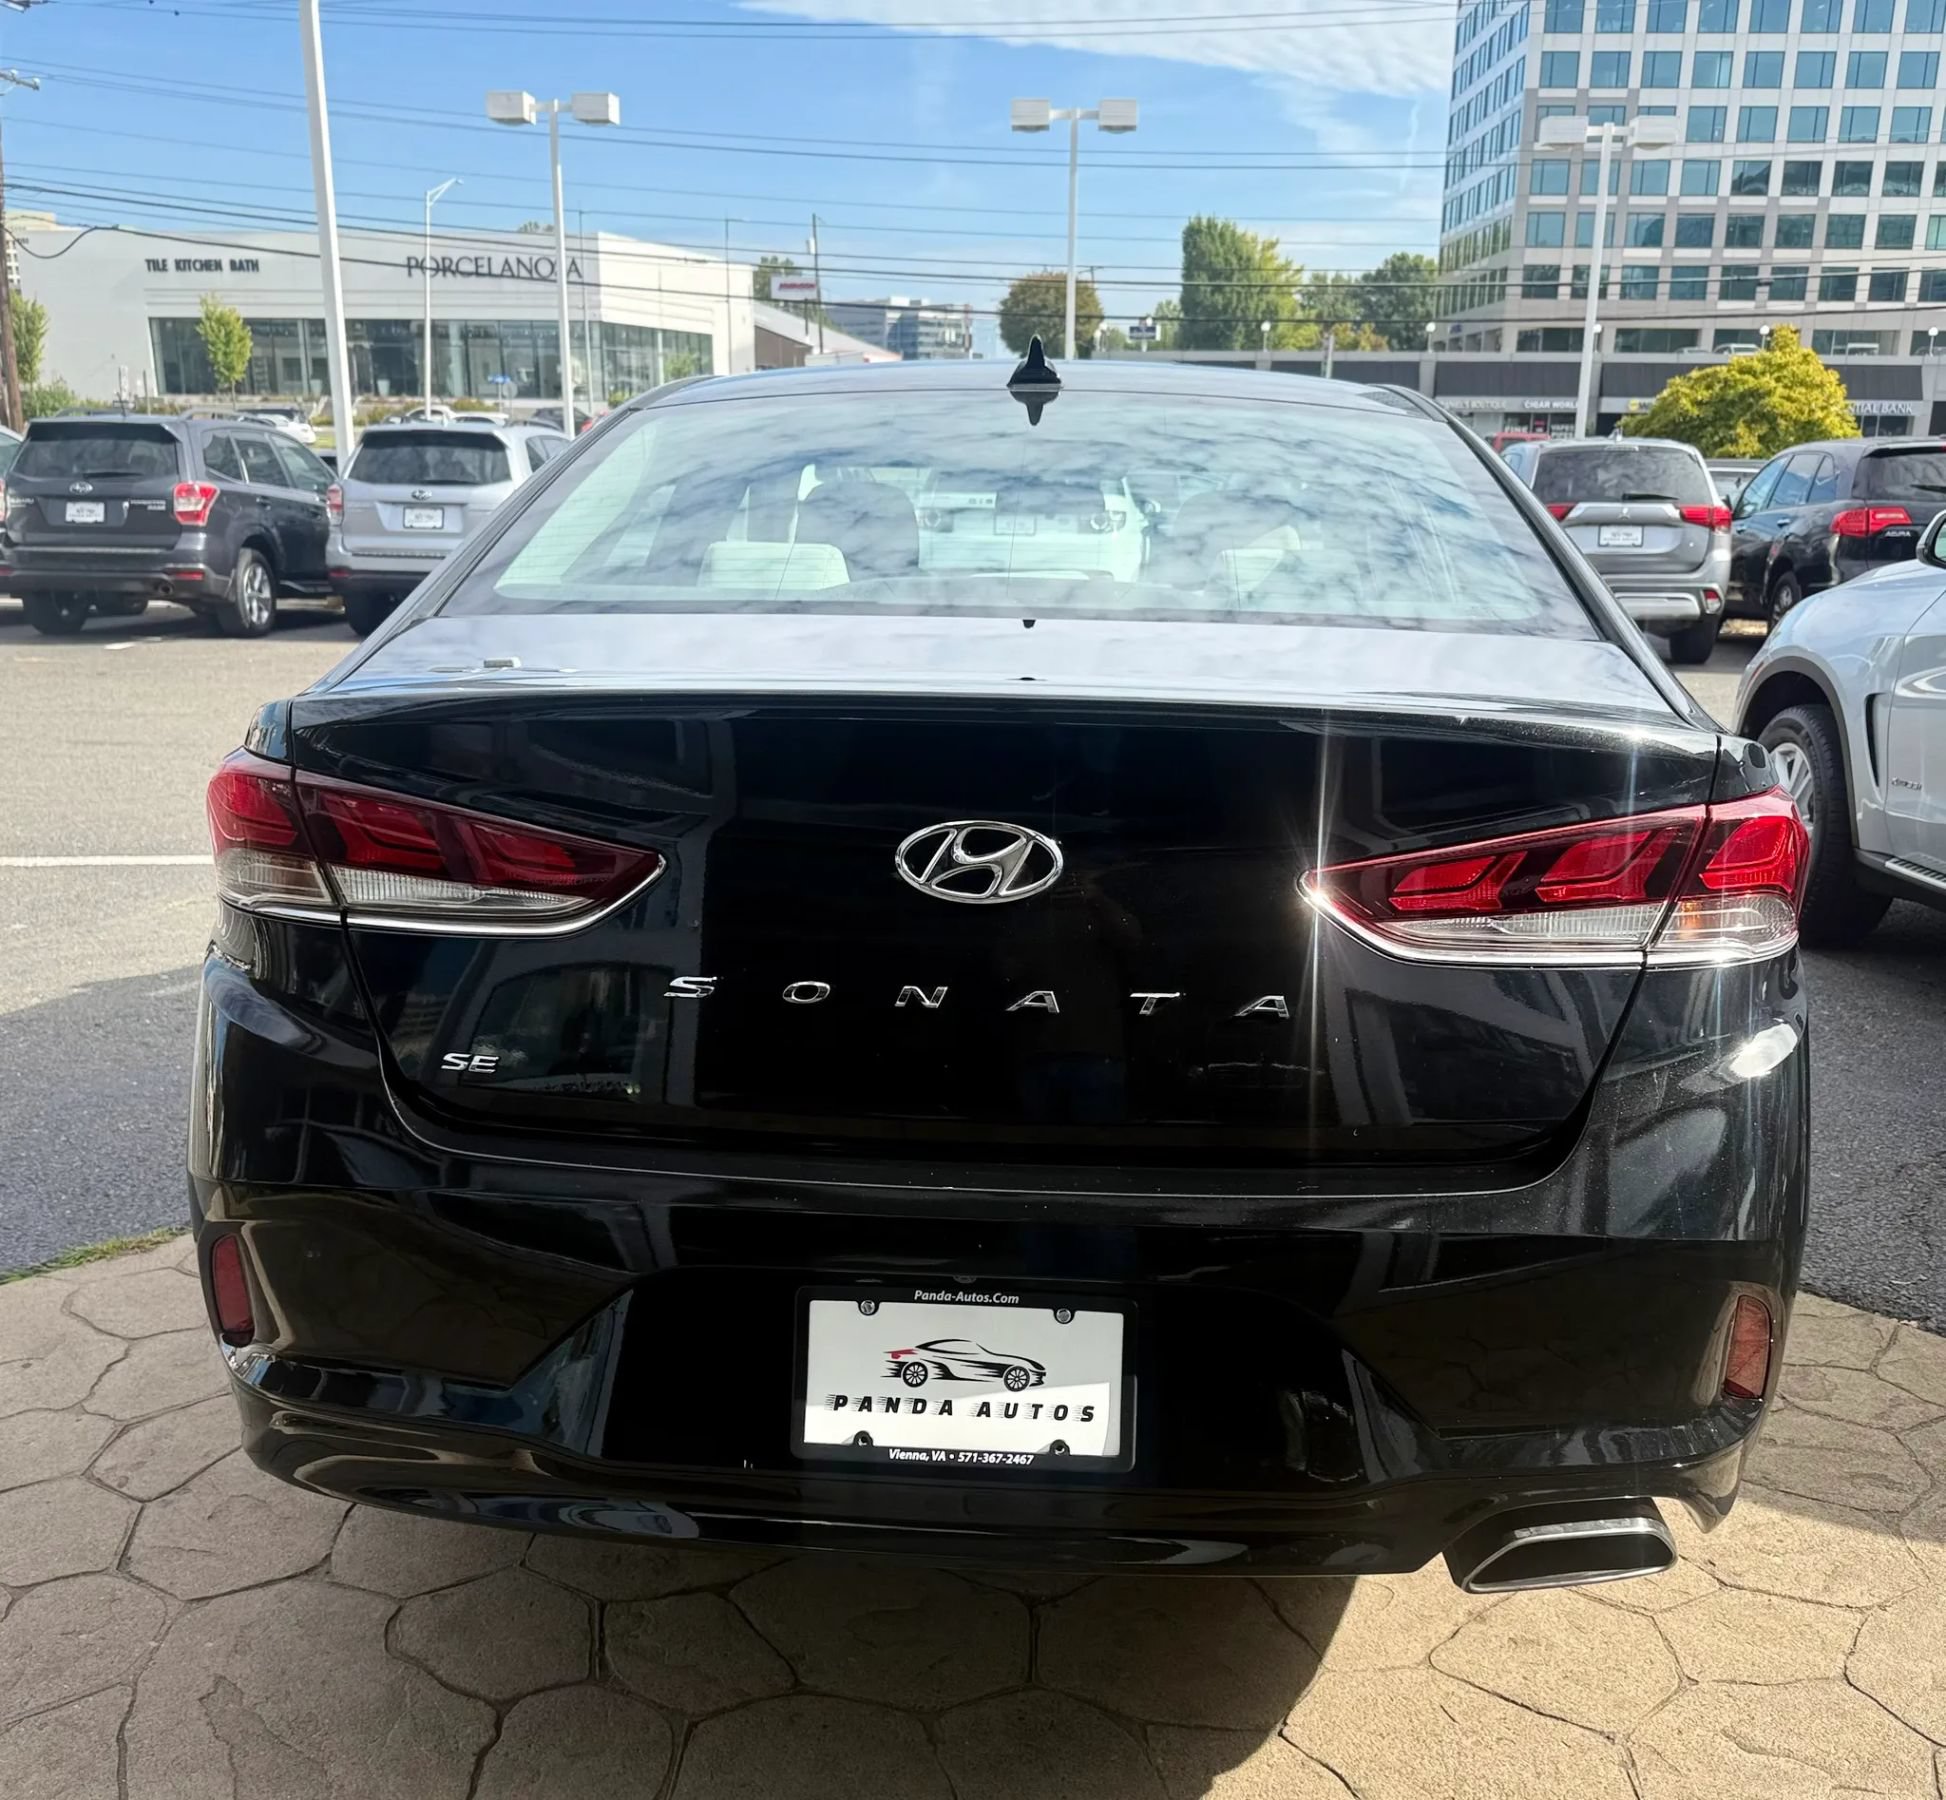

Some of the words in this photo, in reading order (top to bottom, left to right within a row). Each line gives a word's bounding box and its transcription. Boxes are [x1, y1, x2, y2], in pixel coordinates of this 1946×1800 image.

[145, 258, 169, 273] TILE
[174, 258, 223, 273] KITCHEN
[229, 258, 260, 273] BATH
[406, 255, 583, 280] PORCELANOA
[1848, 402, 1879, 414] NTIAL
[1881, 402, 1913, 415] BANK
[663, 976, 1291, 1020] SONATA
[441, 1053, 499, 1074] SE
[914, 1290, 1020, 1304] Panda-Autos.Com
[828, 1394, 953, 1417] PANDA
[972, 1401, 1095, 1423] AUTOS
[889, 1448, 930, 1462] Vienna,
[931, 1451, 947, 1462] VA
[957, 1452, 1035, 1466] 571-367-2467
